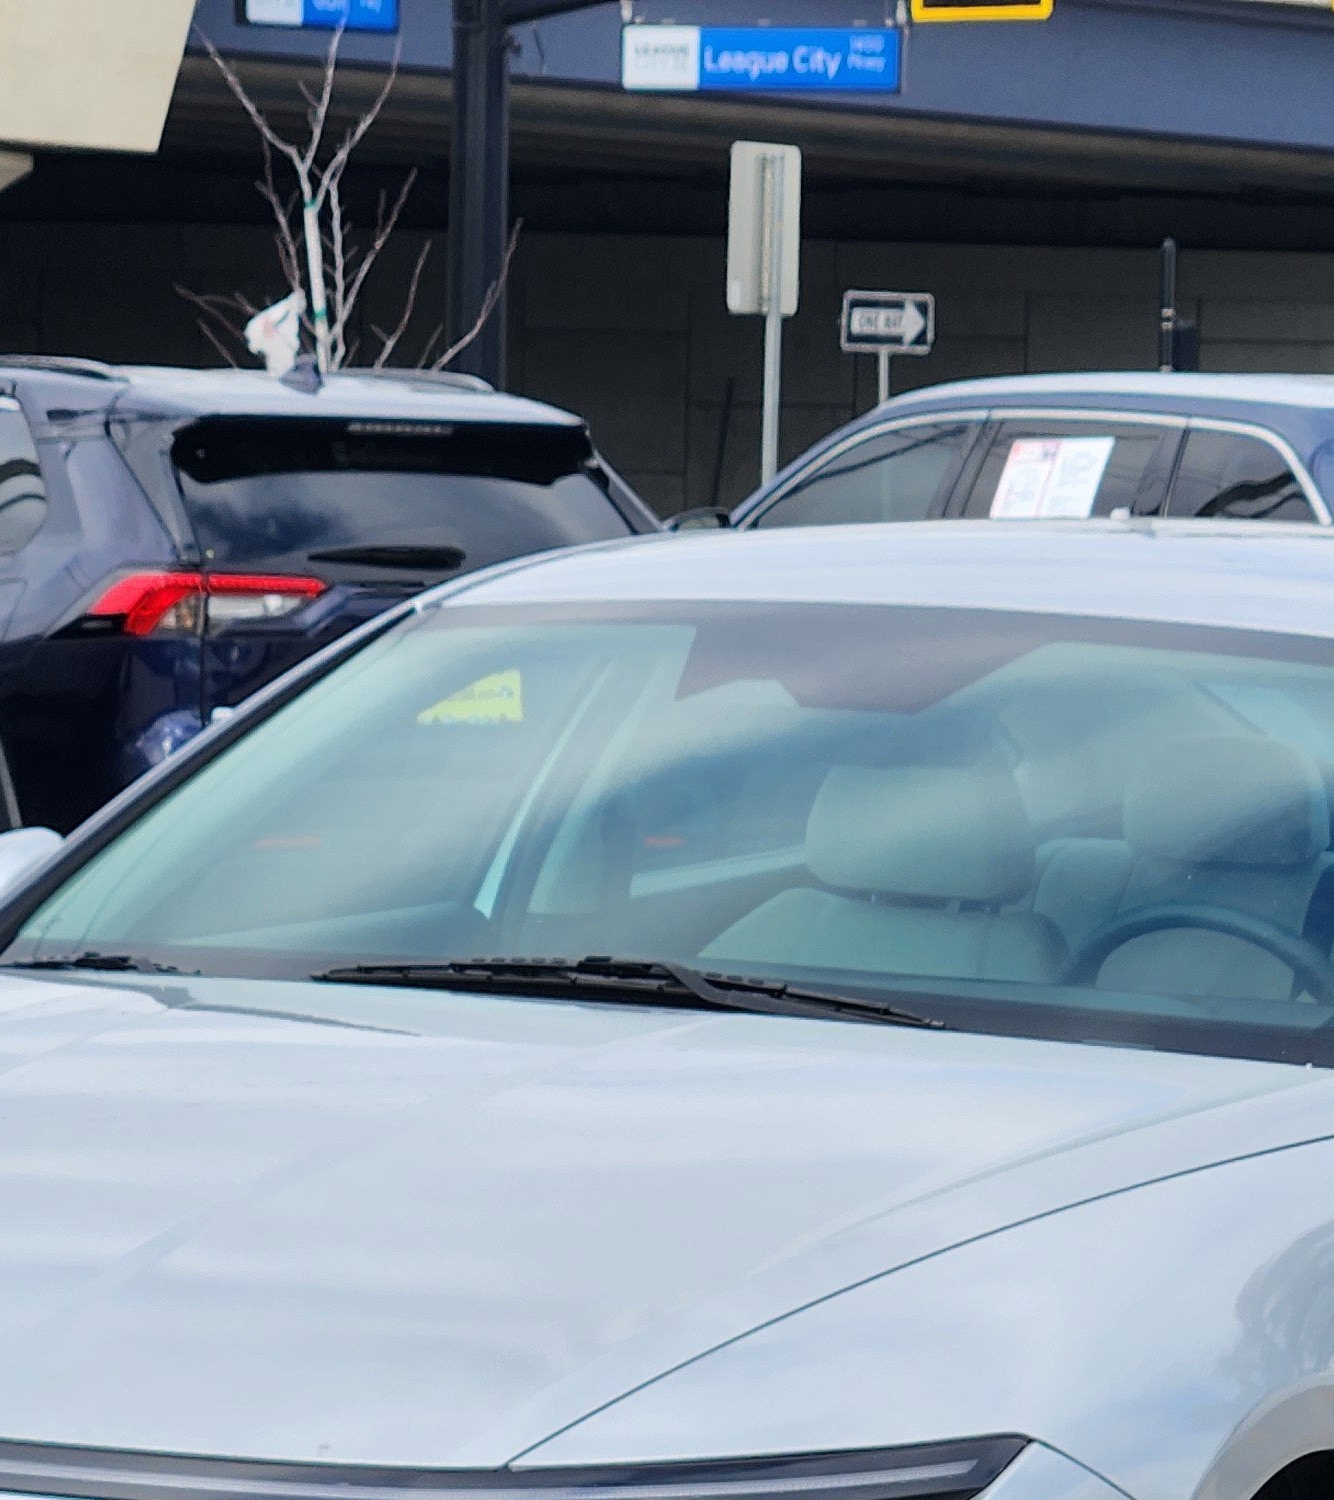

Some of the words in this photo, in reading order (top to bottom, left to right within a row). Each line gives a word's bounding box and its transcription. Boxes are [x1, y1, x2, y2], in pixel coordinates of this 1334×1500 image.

[705, 45, 789, 81] League
[793, 45, 842, 80] City
[859, 312, 878, 331] ONE
